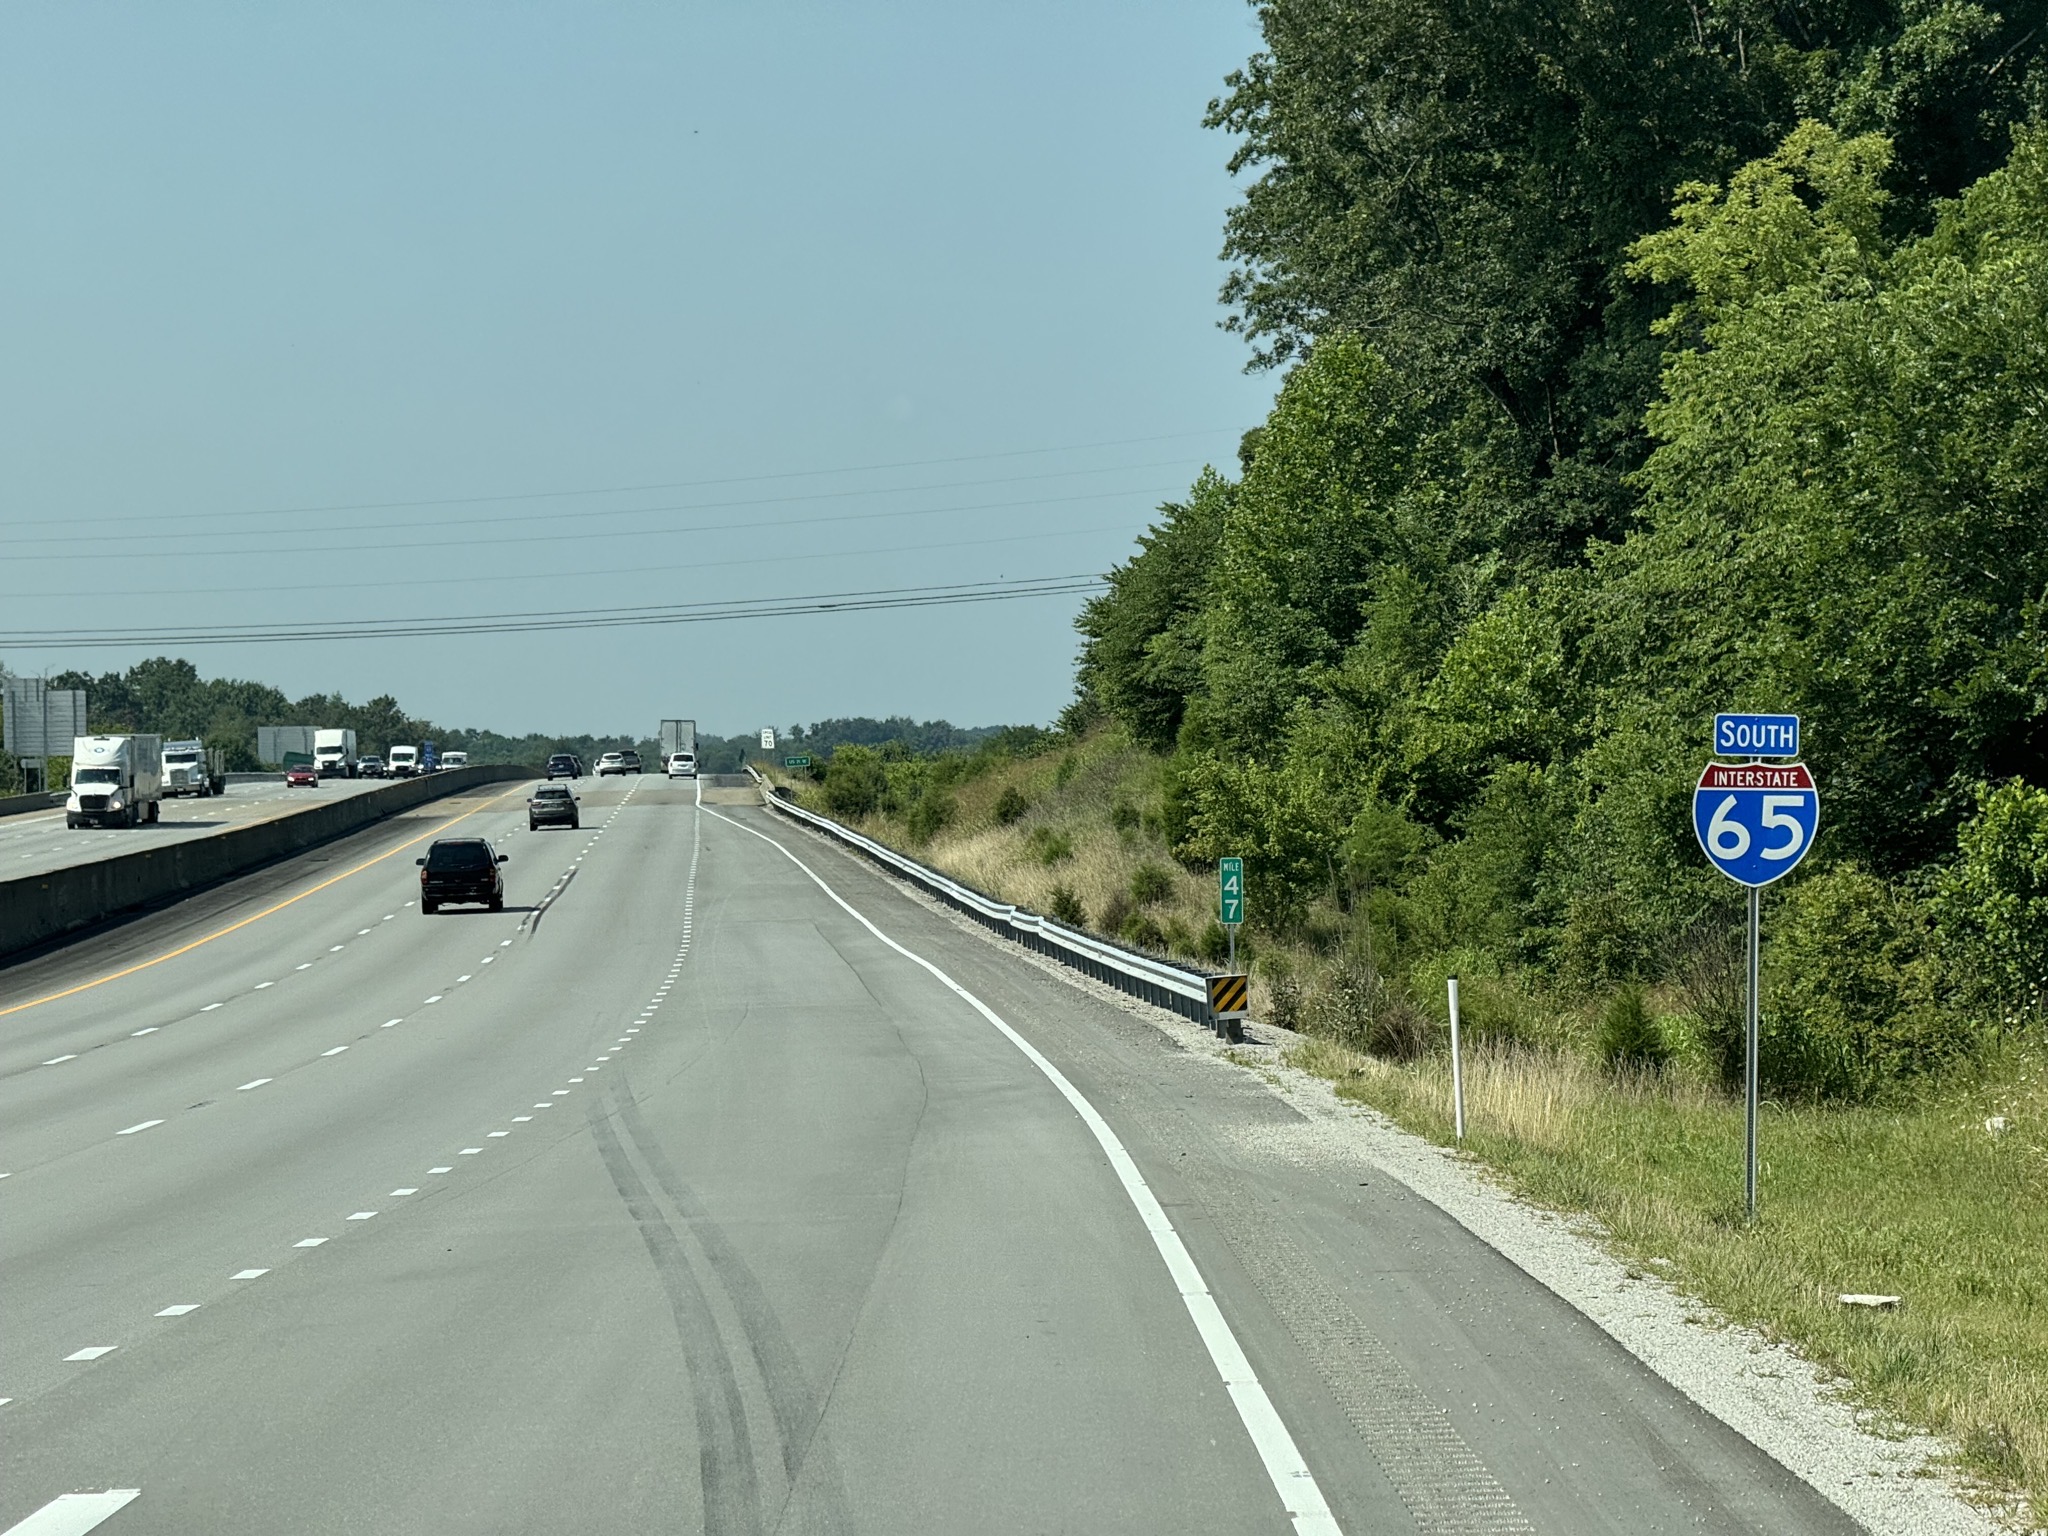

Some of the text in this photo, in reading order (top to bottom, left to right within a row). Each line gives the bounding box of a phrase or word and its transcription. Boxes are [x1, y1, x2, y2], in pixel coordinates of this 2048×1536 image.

[1720, 720, 1794, 748] SOUTH
[1714, 771, 1799, 787] INTERSTATE
[1707, 794, 1805, 860] 65
[1223, 862, 1240, 872] MILE
